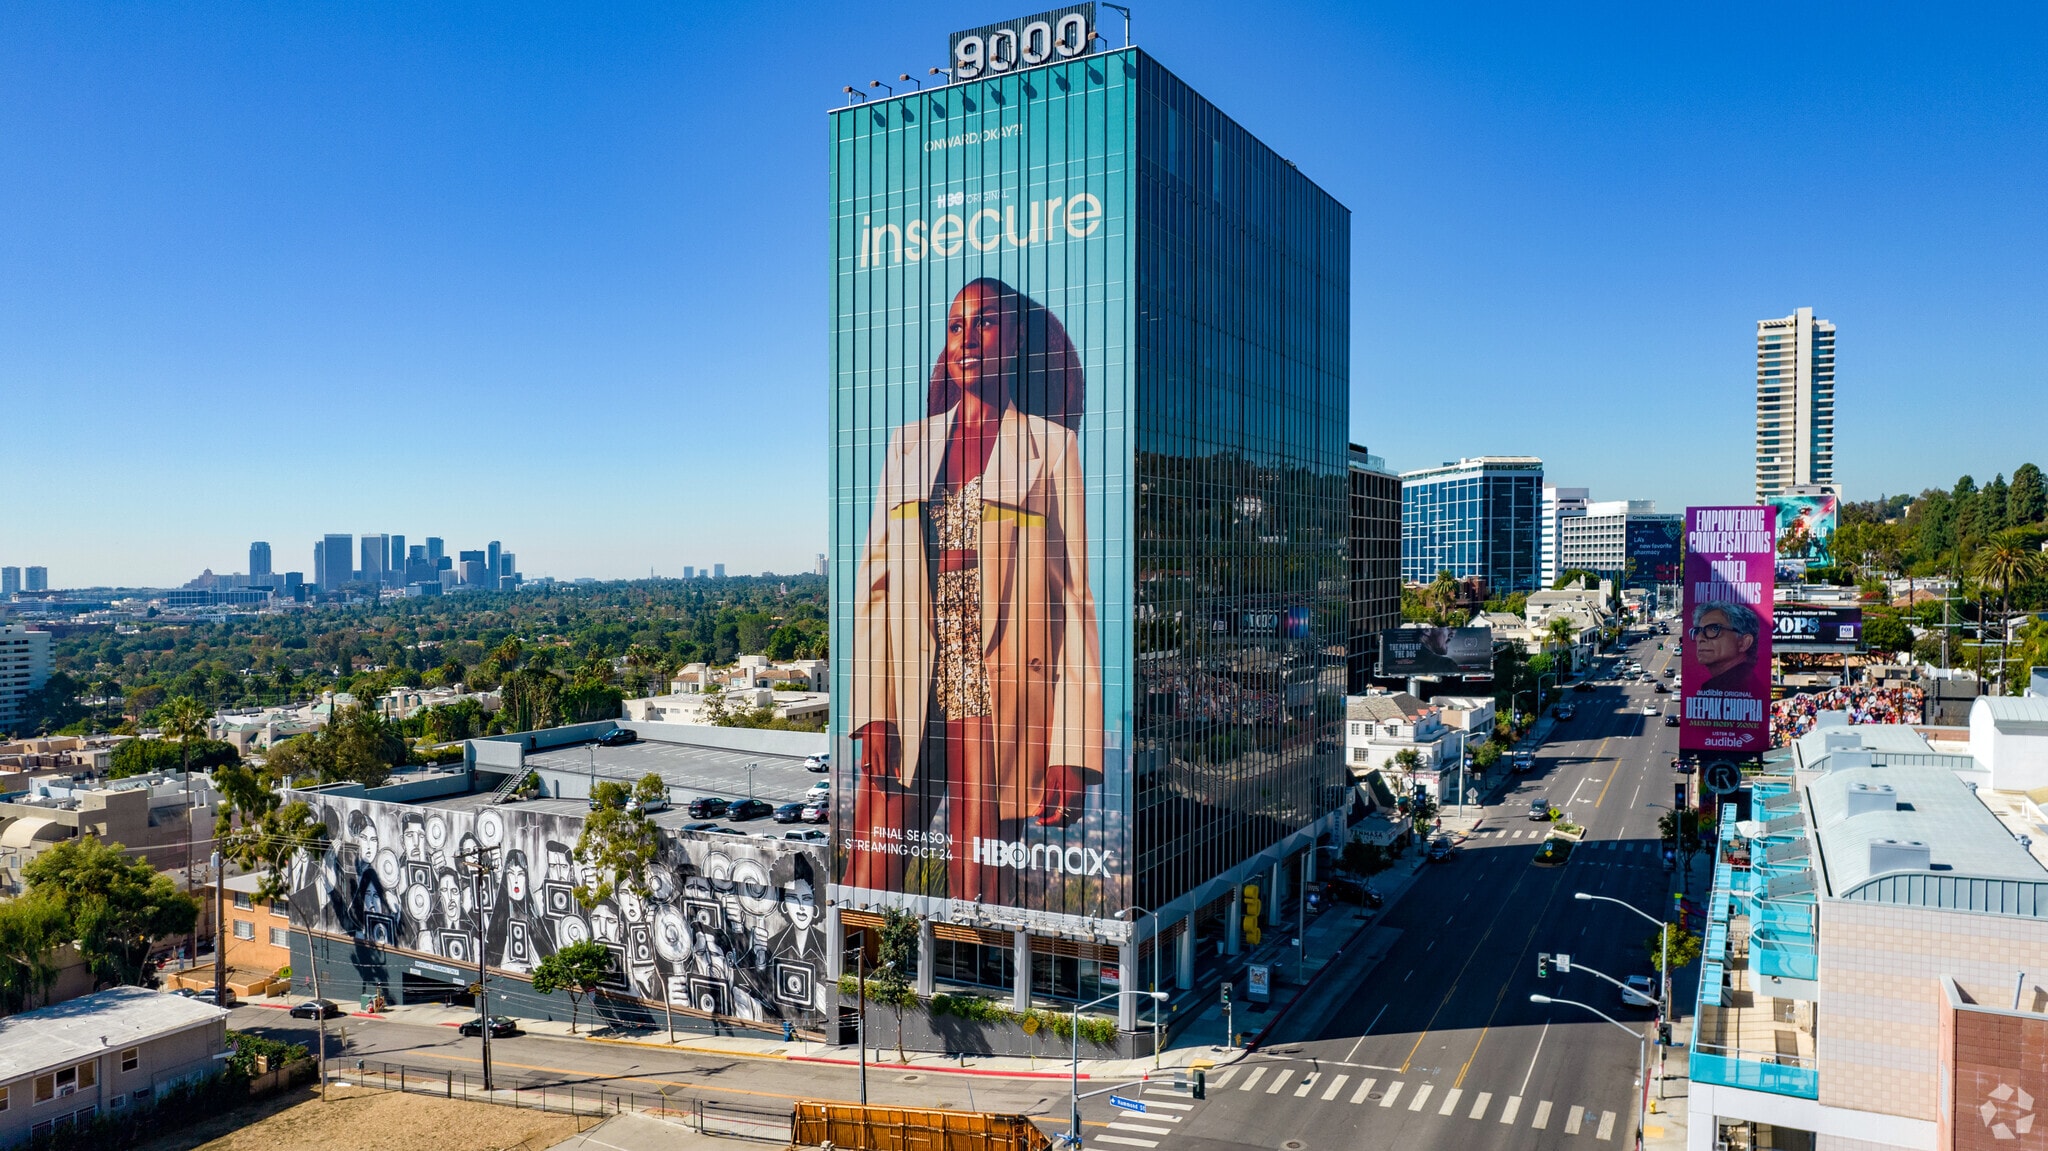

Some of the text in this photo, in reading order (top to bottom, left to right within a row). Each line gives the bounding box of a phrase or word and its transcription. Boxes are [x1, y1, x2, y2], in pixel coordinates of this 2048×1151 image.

[954, 13, 1088, 79] 9000
[937, 189, 1009, 208] HBO ORIGINAL
[860, 192, 1102, 268] insecure
[1696, 509, 1765, 532] EMPOWERING
[1689, 531, 1771, 553] CONVERSATIONS
[1711, 560, 1746, 582] GUIDED
[1694, 582, 1762, 604] MEDITATIONS
[1394, 650, 1417, 658] THE DOG
[1696, 689, 1723, 697] audible
[1685, 696, 1763, 722] DEEPAK CHOPRA
[1713, 720, 1735, 728] BODY
[1704, 737, 1743, 748] audible
[873, 826, 953, 845] FINAL SEASON
[845, 838, 953, 861] STREAMING OCT 24
[1117, 1099, 1138, 1110] Hammond
